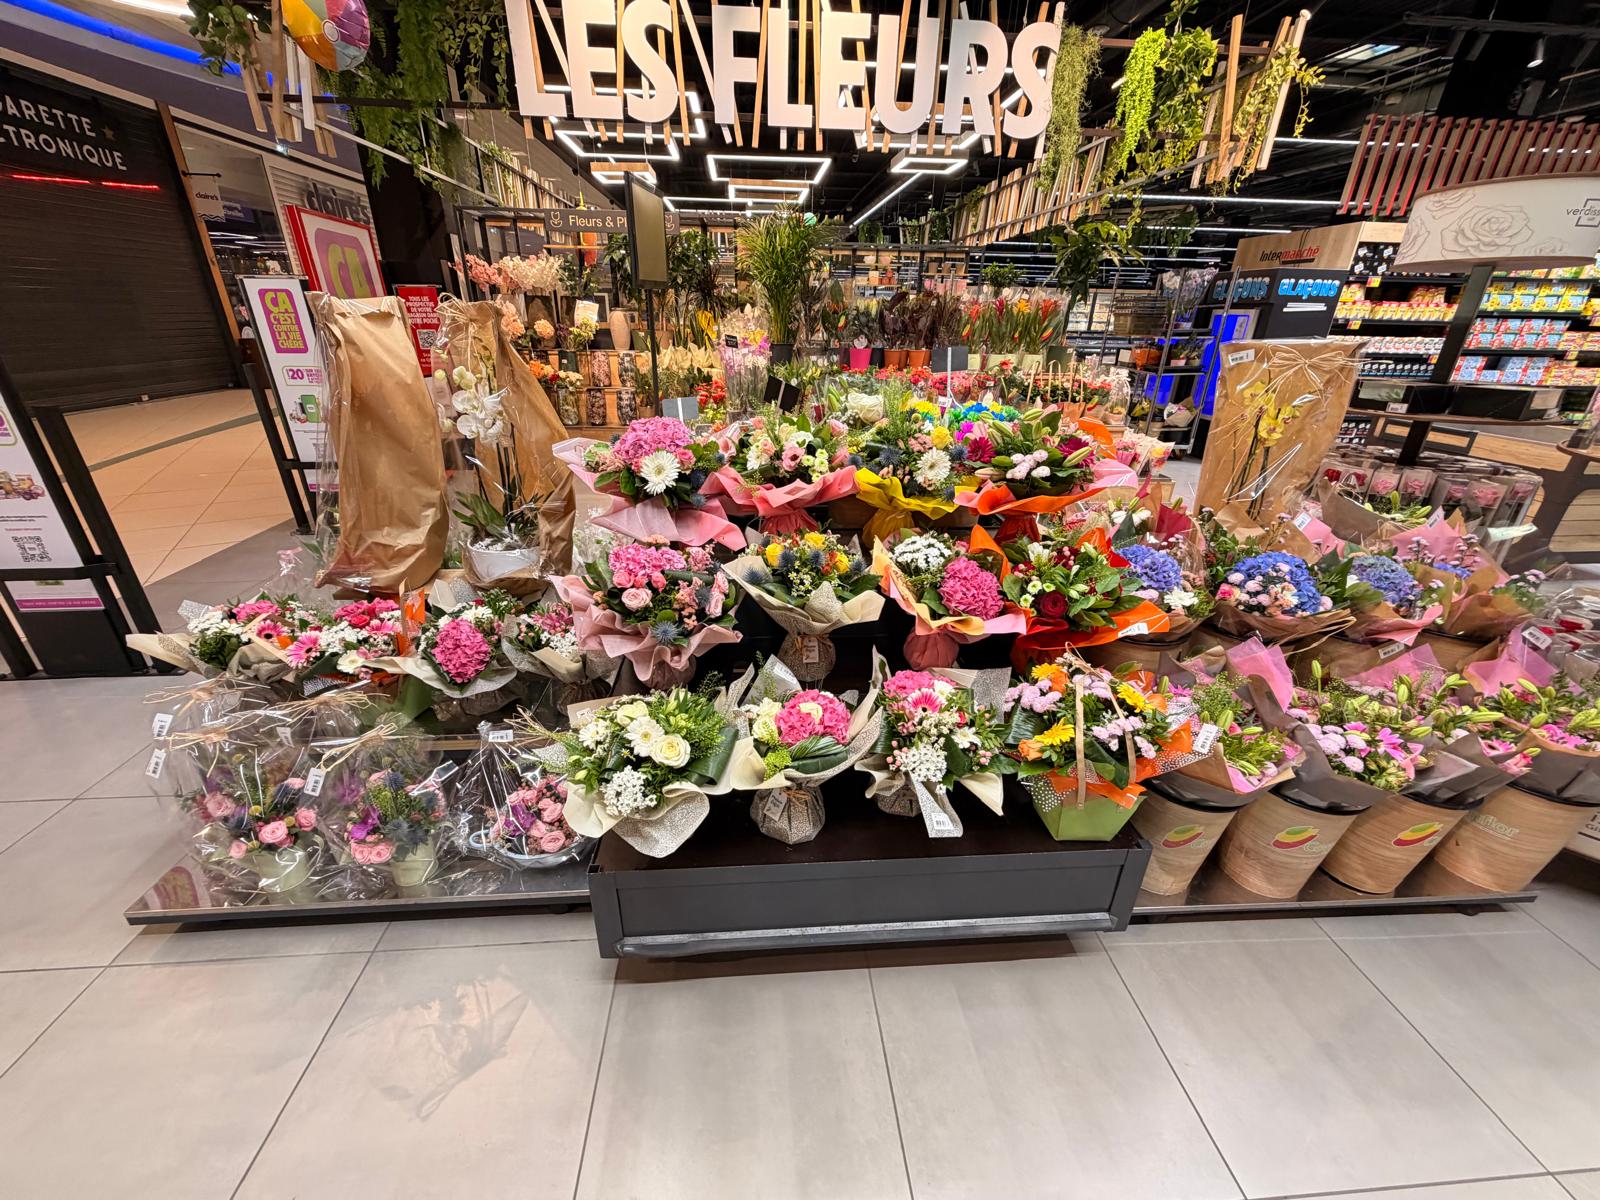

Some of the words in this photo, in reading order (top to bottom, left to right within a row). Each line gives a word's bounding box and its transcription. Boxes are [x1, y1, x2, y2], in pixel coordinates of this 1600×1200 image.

[502, 0, 678, 123] LES
[712, 5, 1061, 140] FLEURS
[0, 94, 97, 138] ARETTE
[0, 124, 128, 171] TRONIQUE
[569, 215, 602, 227] Fleurs
[605, 216, 614, 228] &
[1260, 246, 1320, 262] Intermarché
[1278, 277, 1340, 300] GLAÇONS
